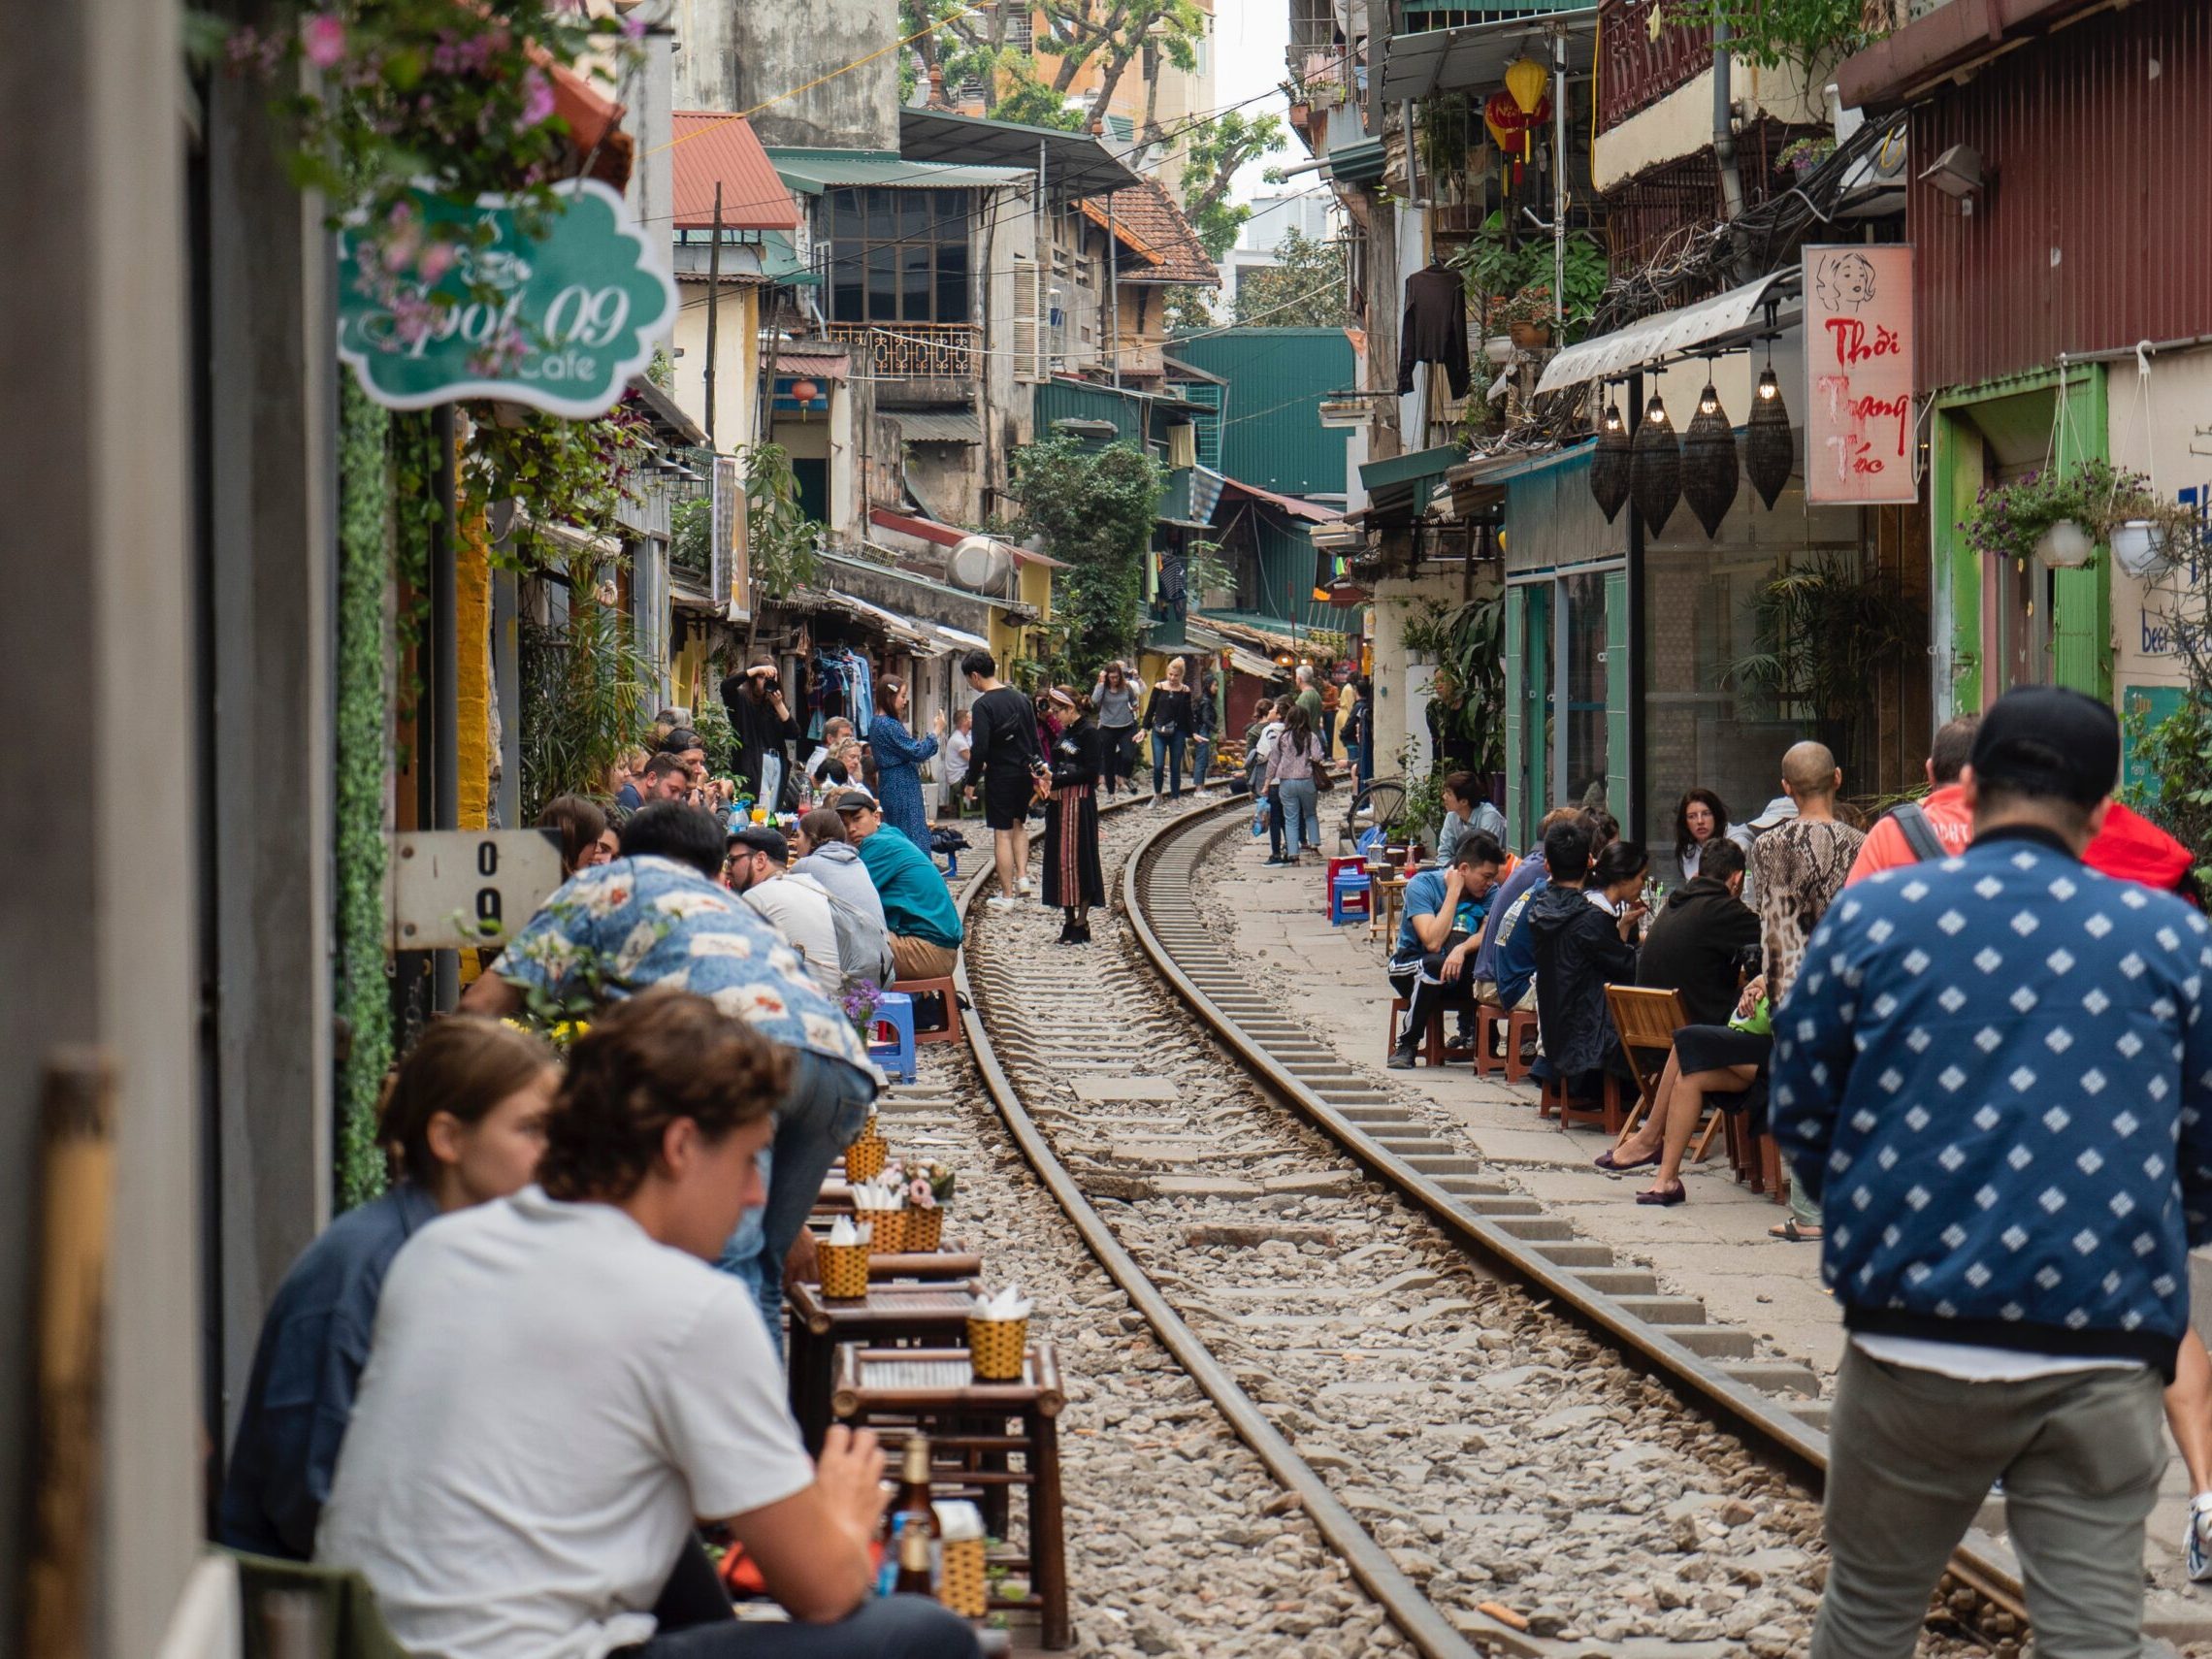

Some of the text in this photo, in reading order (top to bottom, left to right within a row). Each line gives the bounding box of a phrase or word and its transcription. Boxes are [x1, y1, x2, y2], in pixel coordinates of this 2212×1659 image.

[543, 285, 629, 347] 09
[1825, 318, 1901, 365] Thời
[519, 345, 597, 380] Cafe
[1818, 375, 1910, 456] Trang
